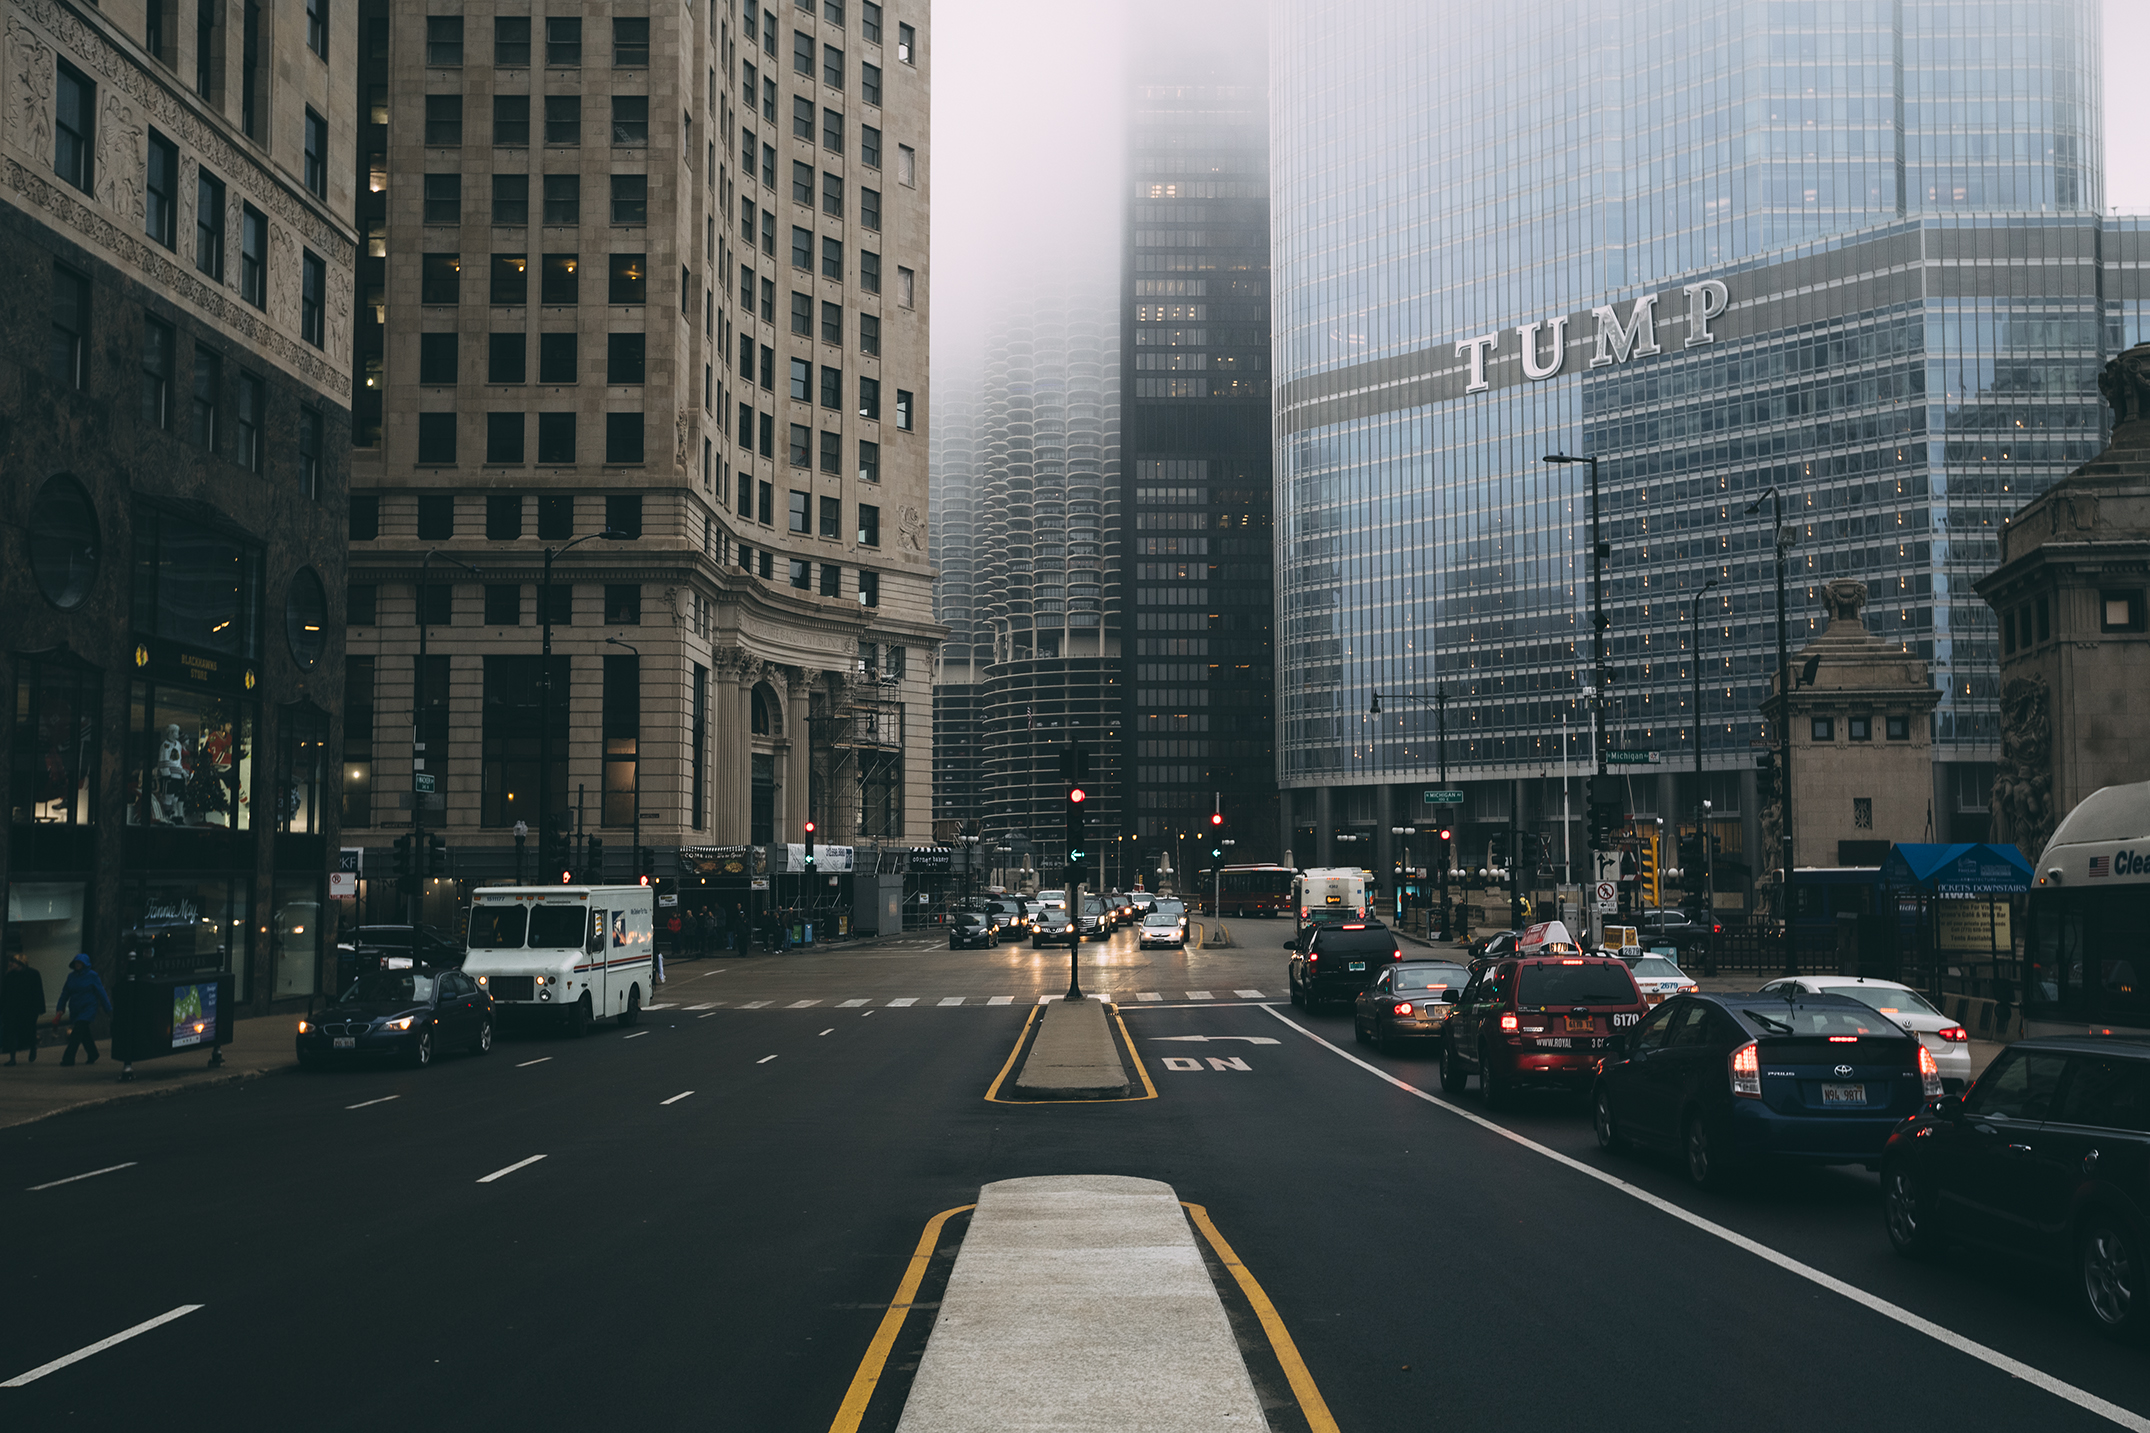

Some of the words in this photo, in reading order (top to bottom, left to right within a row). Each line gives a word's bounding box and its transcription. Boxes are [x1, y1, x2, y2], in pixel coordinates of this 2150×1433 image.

[1455, 279, 1729, 395] TUMP
[1611, 752, 1643, 762] Michigan
[339, 856, 356, 869] KF
[1937, 884, 1971, 893] TICKETS
[1973, 884, 2027, 893] DOWNSTAIRS
[144, 897, 180, 920] Fannie
[177, 898, 199, 923] May
[1549, 942, 1568, 952] 6170
[1623, 947, 1640, 955] 2679
[1613, 1013, 1641, 1027] 6170
[1536, 1038, 1572, 1048] WWW.ROYAL
[1160, 1056, 1253, 1072] ON
[1824, 1089, 1840, 1101] N94
[1843, 1089, 1863, 1101] 9877
